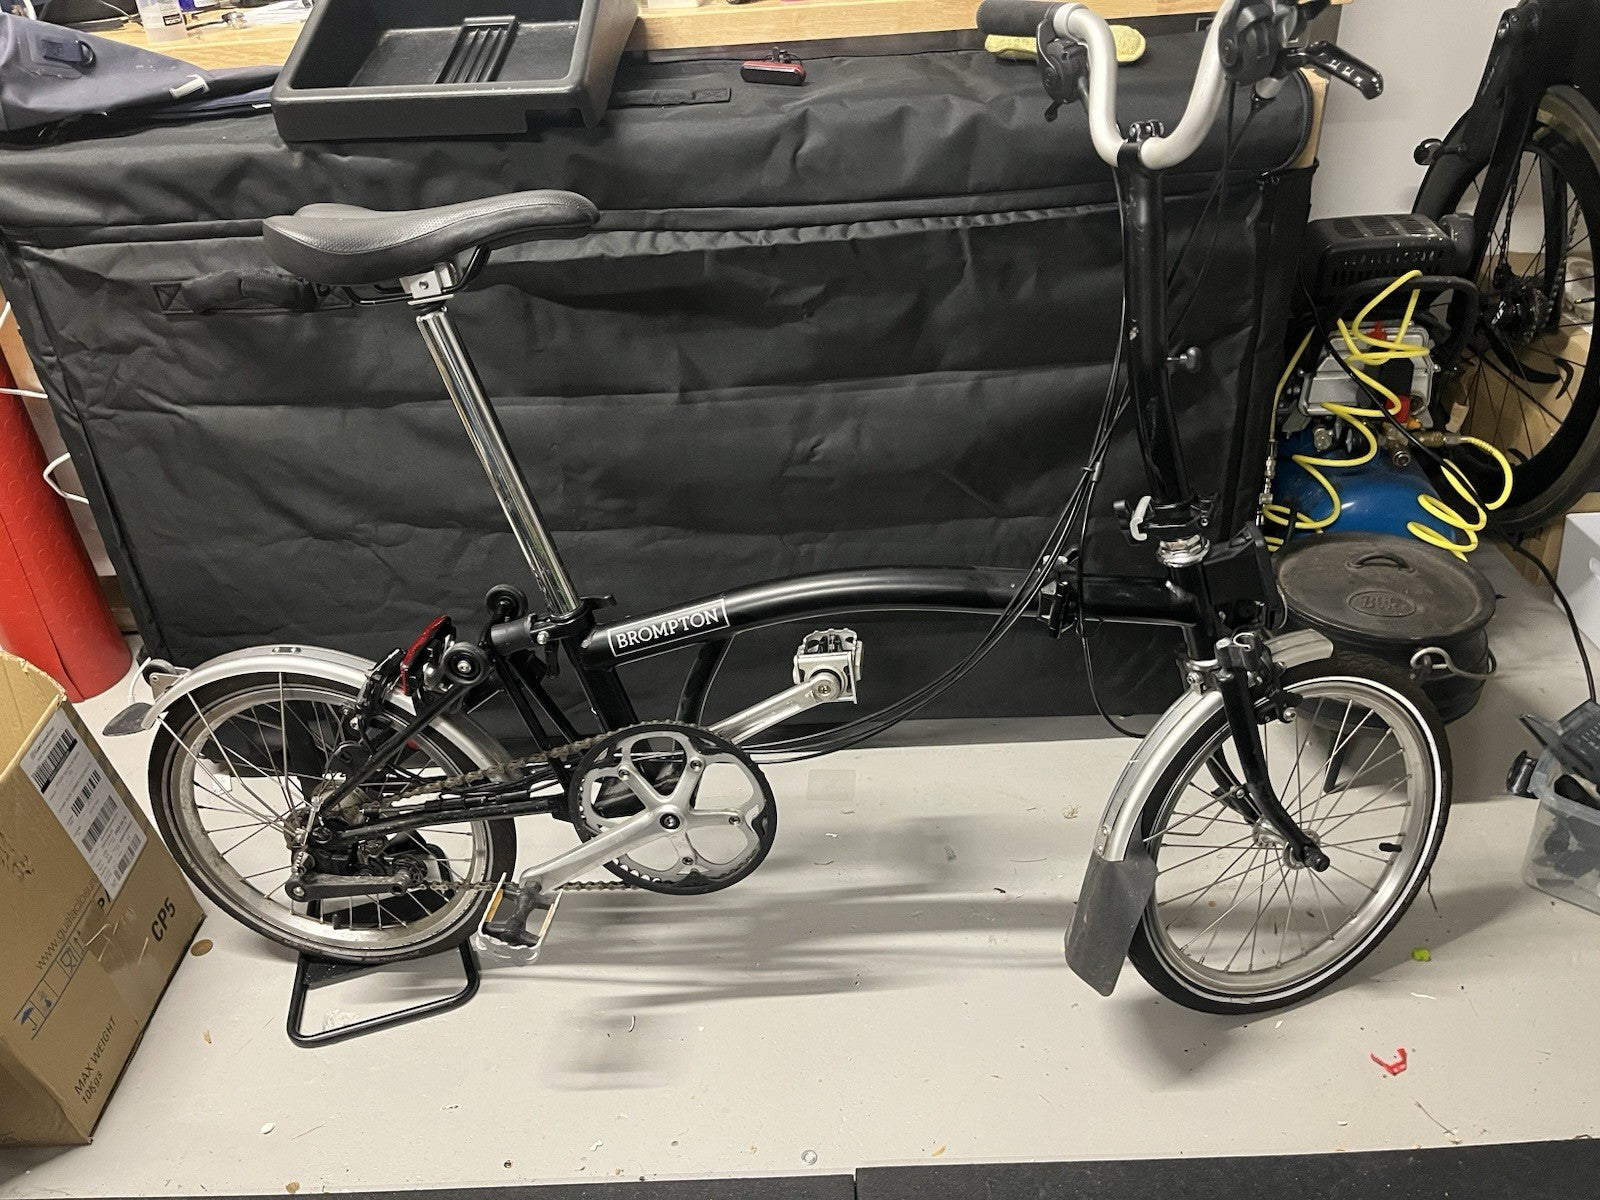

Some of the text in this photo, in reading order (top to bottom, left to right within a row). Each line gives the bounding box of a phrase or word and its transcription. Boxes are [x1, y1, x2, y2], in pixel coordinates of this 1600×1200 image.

[615, 608, 719, 648] BROMPTON
[36, 877, 99, 970] www.gualaclosur
[151, 897, 175, 942] CP5
[74, 1015, 117, 1095] MAX WEIGHT
[82, 1070, 103, 1104] 10Kgs
